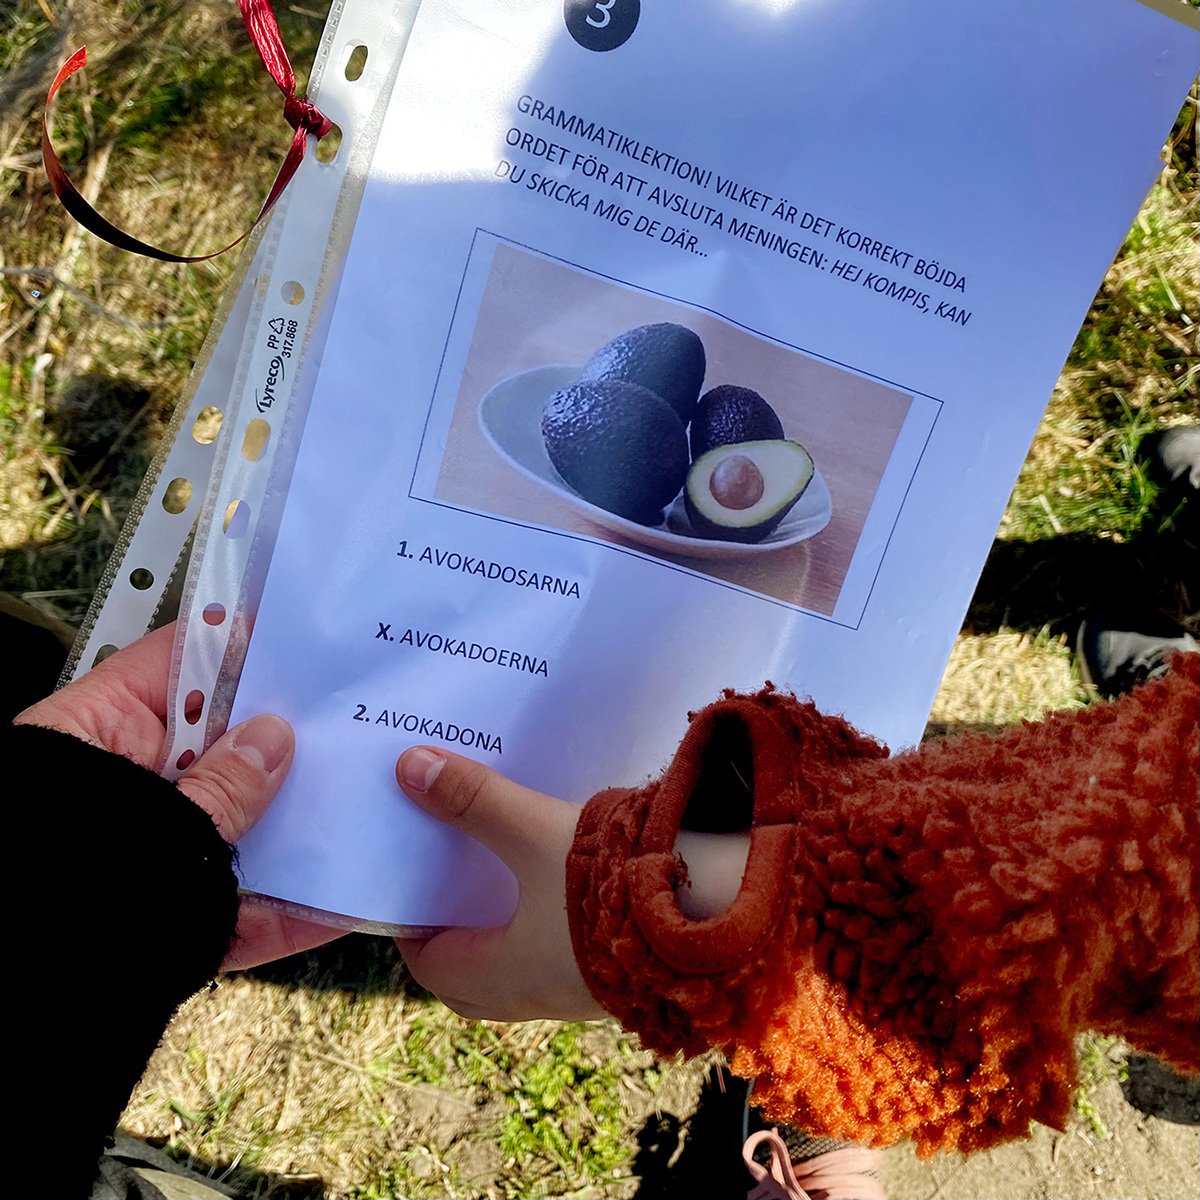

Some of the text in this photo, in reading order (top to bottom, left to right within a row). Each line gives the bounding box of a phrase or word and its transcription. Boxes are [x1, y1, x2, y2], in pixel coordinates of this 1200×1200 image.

[585, 0, 616, 29] 3
[494, 159, 708, 258] DU SKICKA MIG DE DÄR...
[516, 94, 967, 294] GRAMMATIKLEKTION! VILKET ÄR DET KORREKT BÖJDA
[505, 127, 972, 327] ORDET FÖR ATT AVSLUTA MENINGEN: HEJ KOMPIS, KAN
[266, 334, 280, 350] PP
[281, 319, 299, 359] 317.868
[259, 357, 281, 409] Lyreco
[396, 540, 582, 599] 1. AVOKADOSARNA
[375, 621, 550, 678] X. AVOKADOERNA
[352, 703, 504, 755] 2. AVOKADONA
